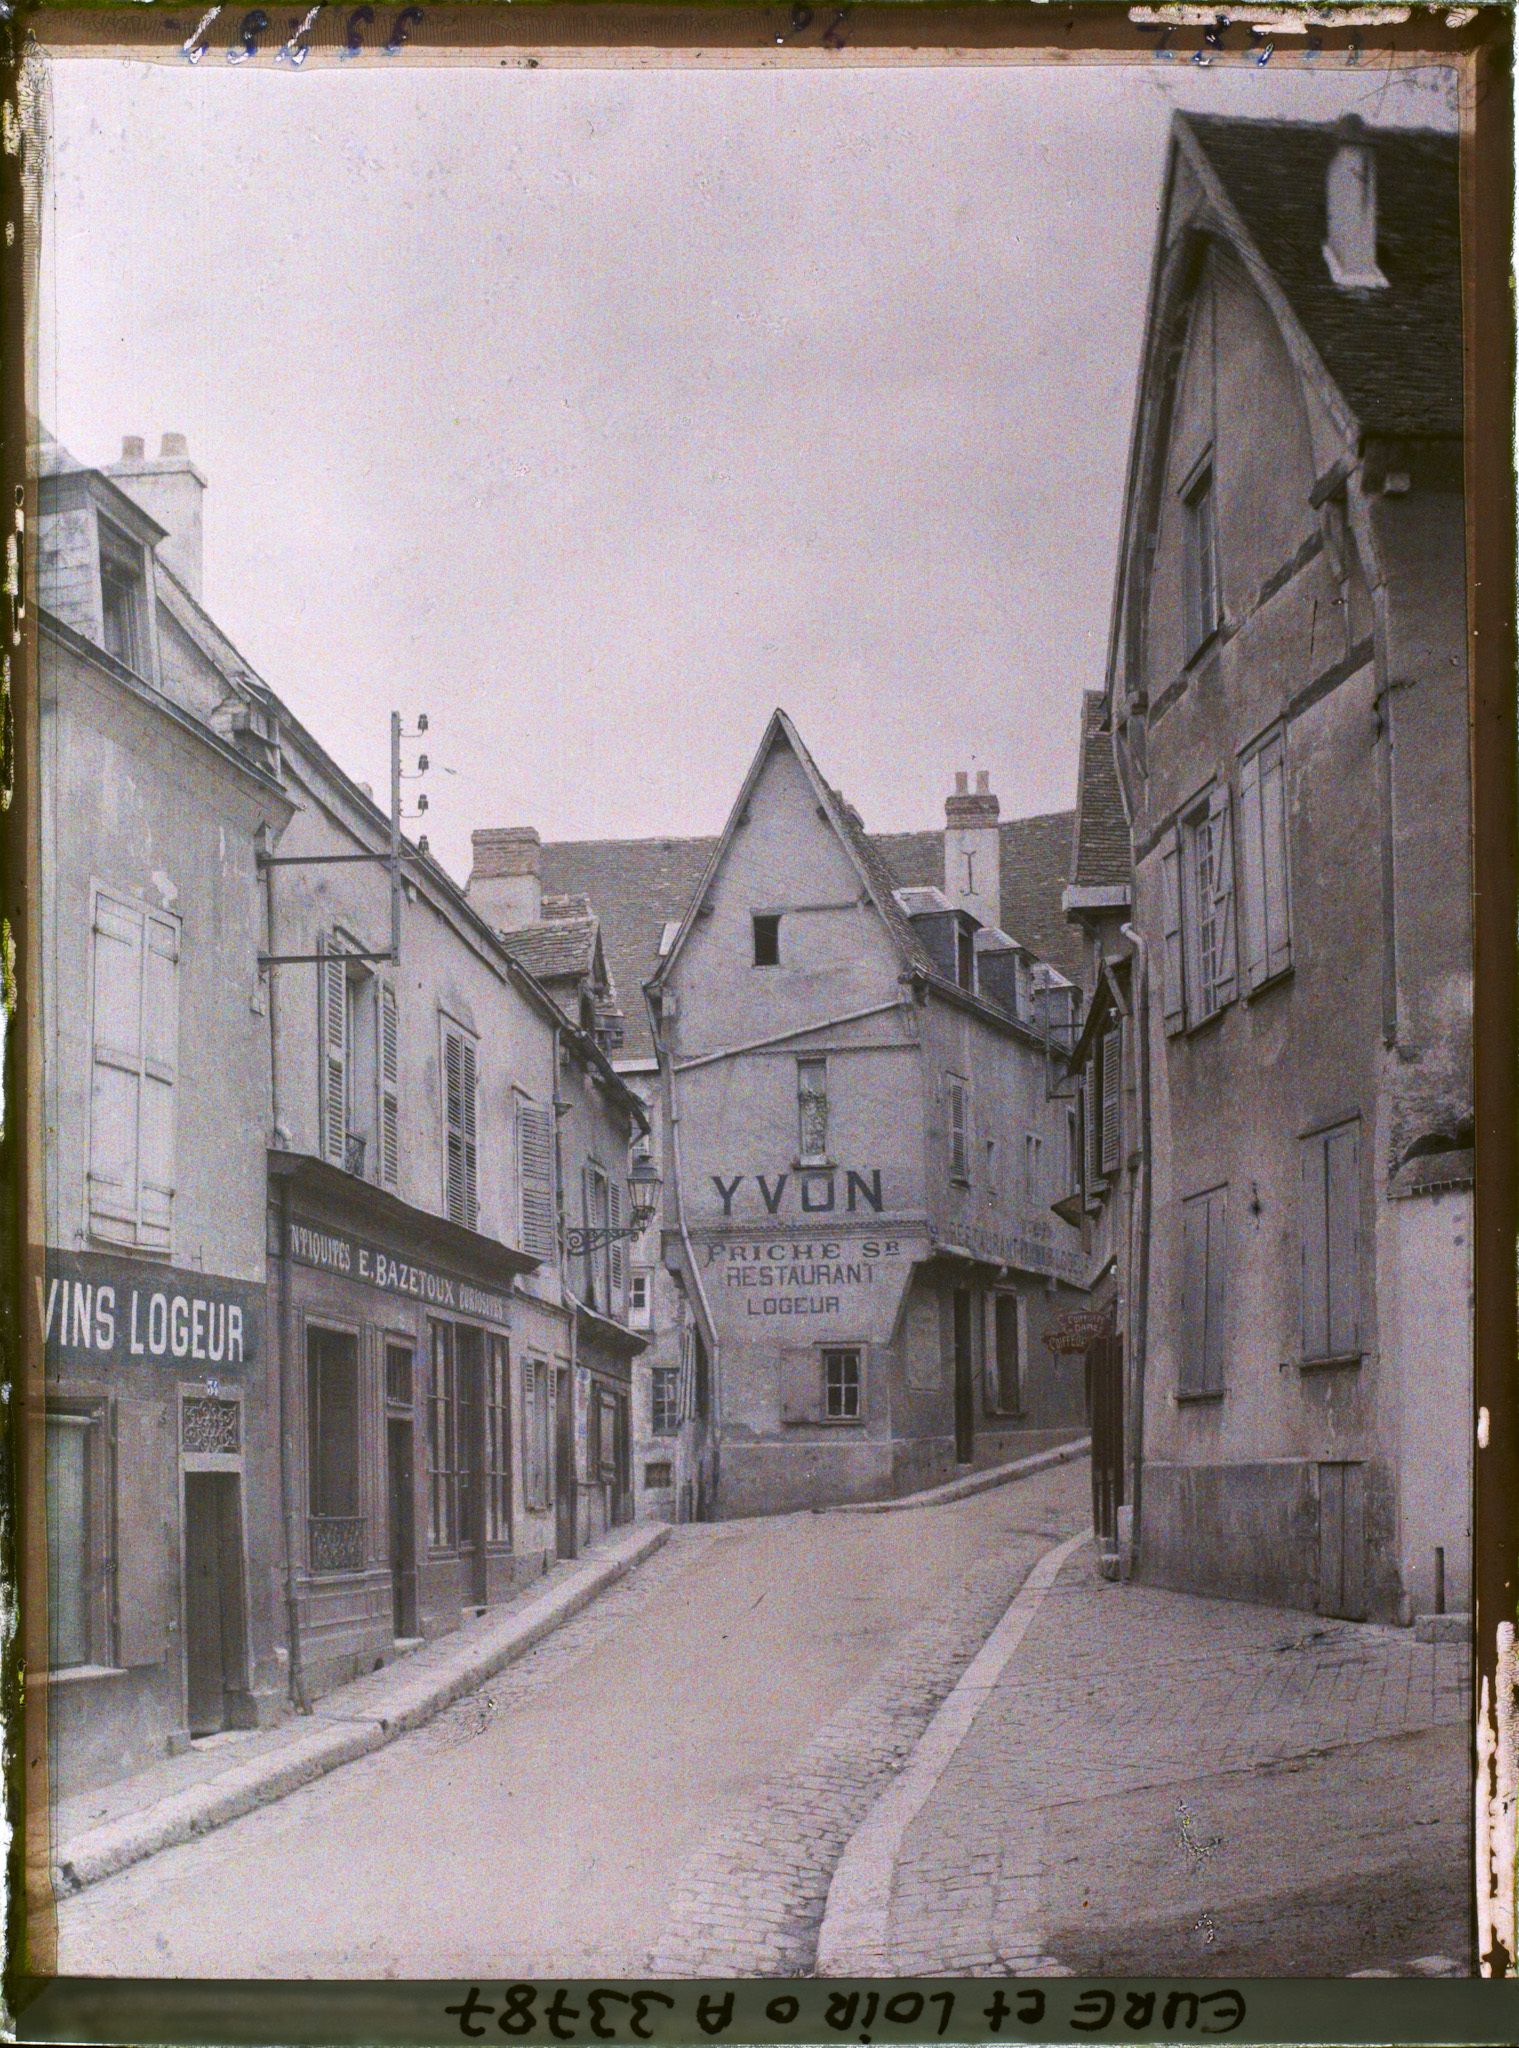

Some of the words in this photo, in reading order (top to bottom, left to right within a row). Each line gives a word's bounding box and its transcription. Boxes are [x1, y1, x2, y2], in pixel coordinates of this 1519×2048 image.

[710, 1168, 884, 1215] YVON
[726, 1263, 875, 1287] RESTAURANT
[34, 1275, 115, 1351] VINS
[130, 1290, 244, 1363] LOGEUR
[747, 1297, 840, 1315] LOGEUR
[445, 1983, 676, 2039] 33787
[696, 1991, 735, 2034] A
[982, 1990, 1046, 2032] et
[1069, 1988, 1247, 2034] EURE
